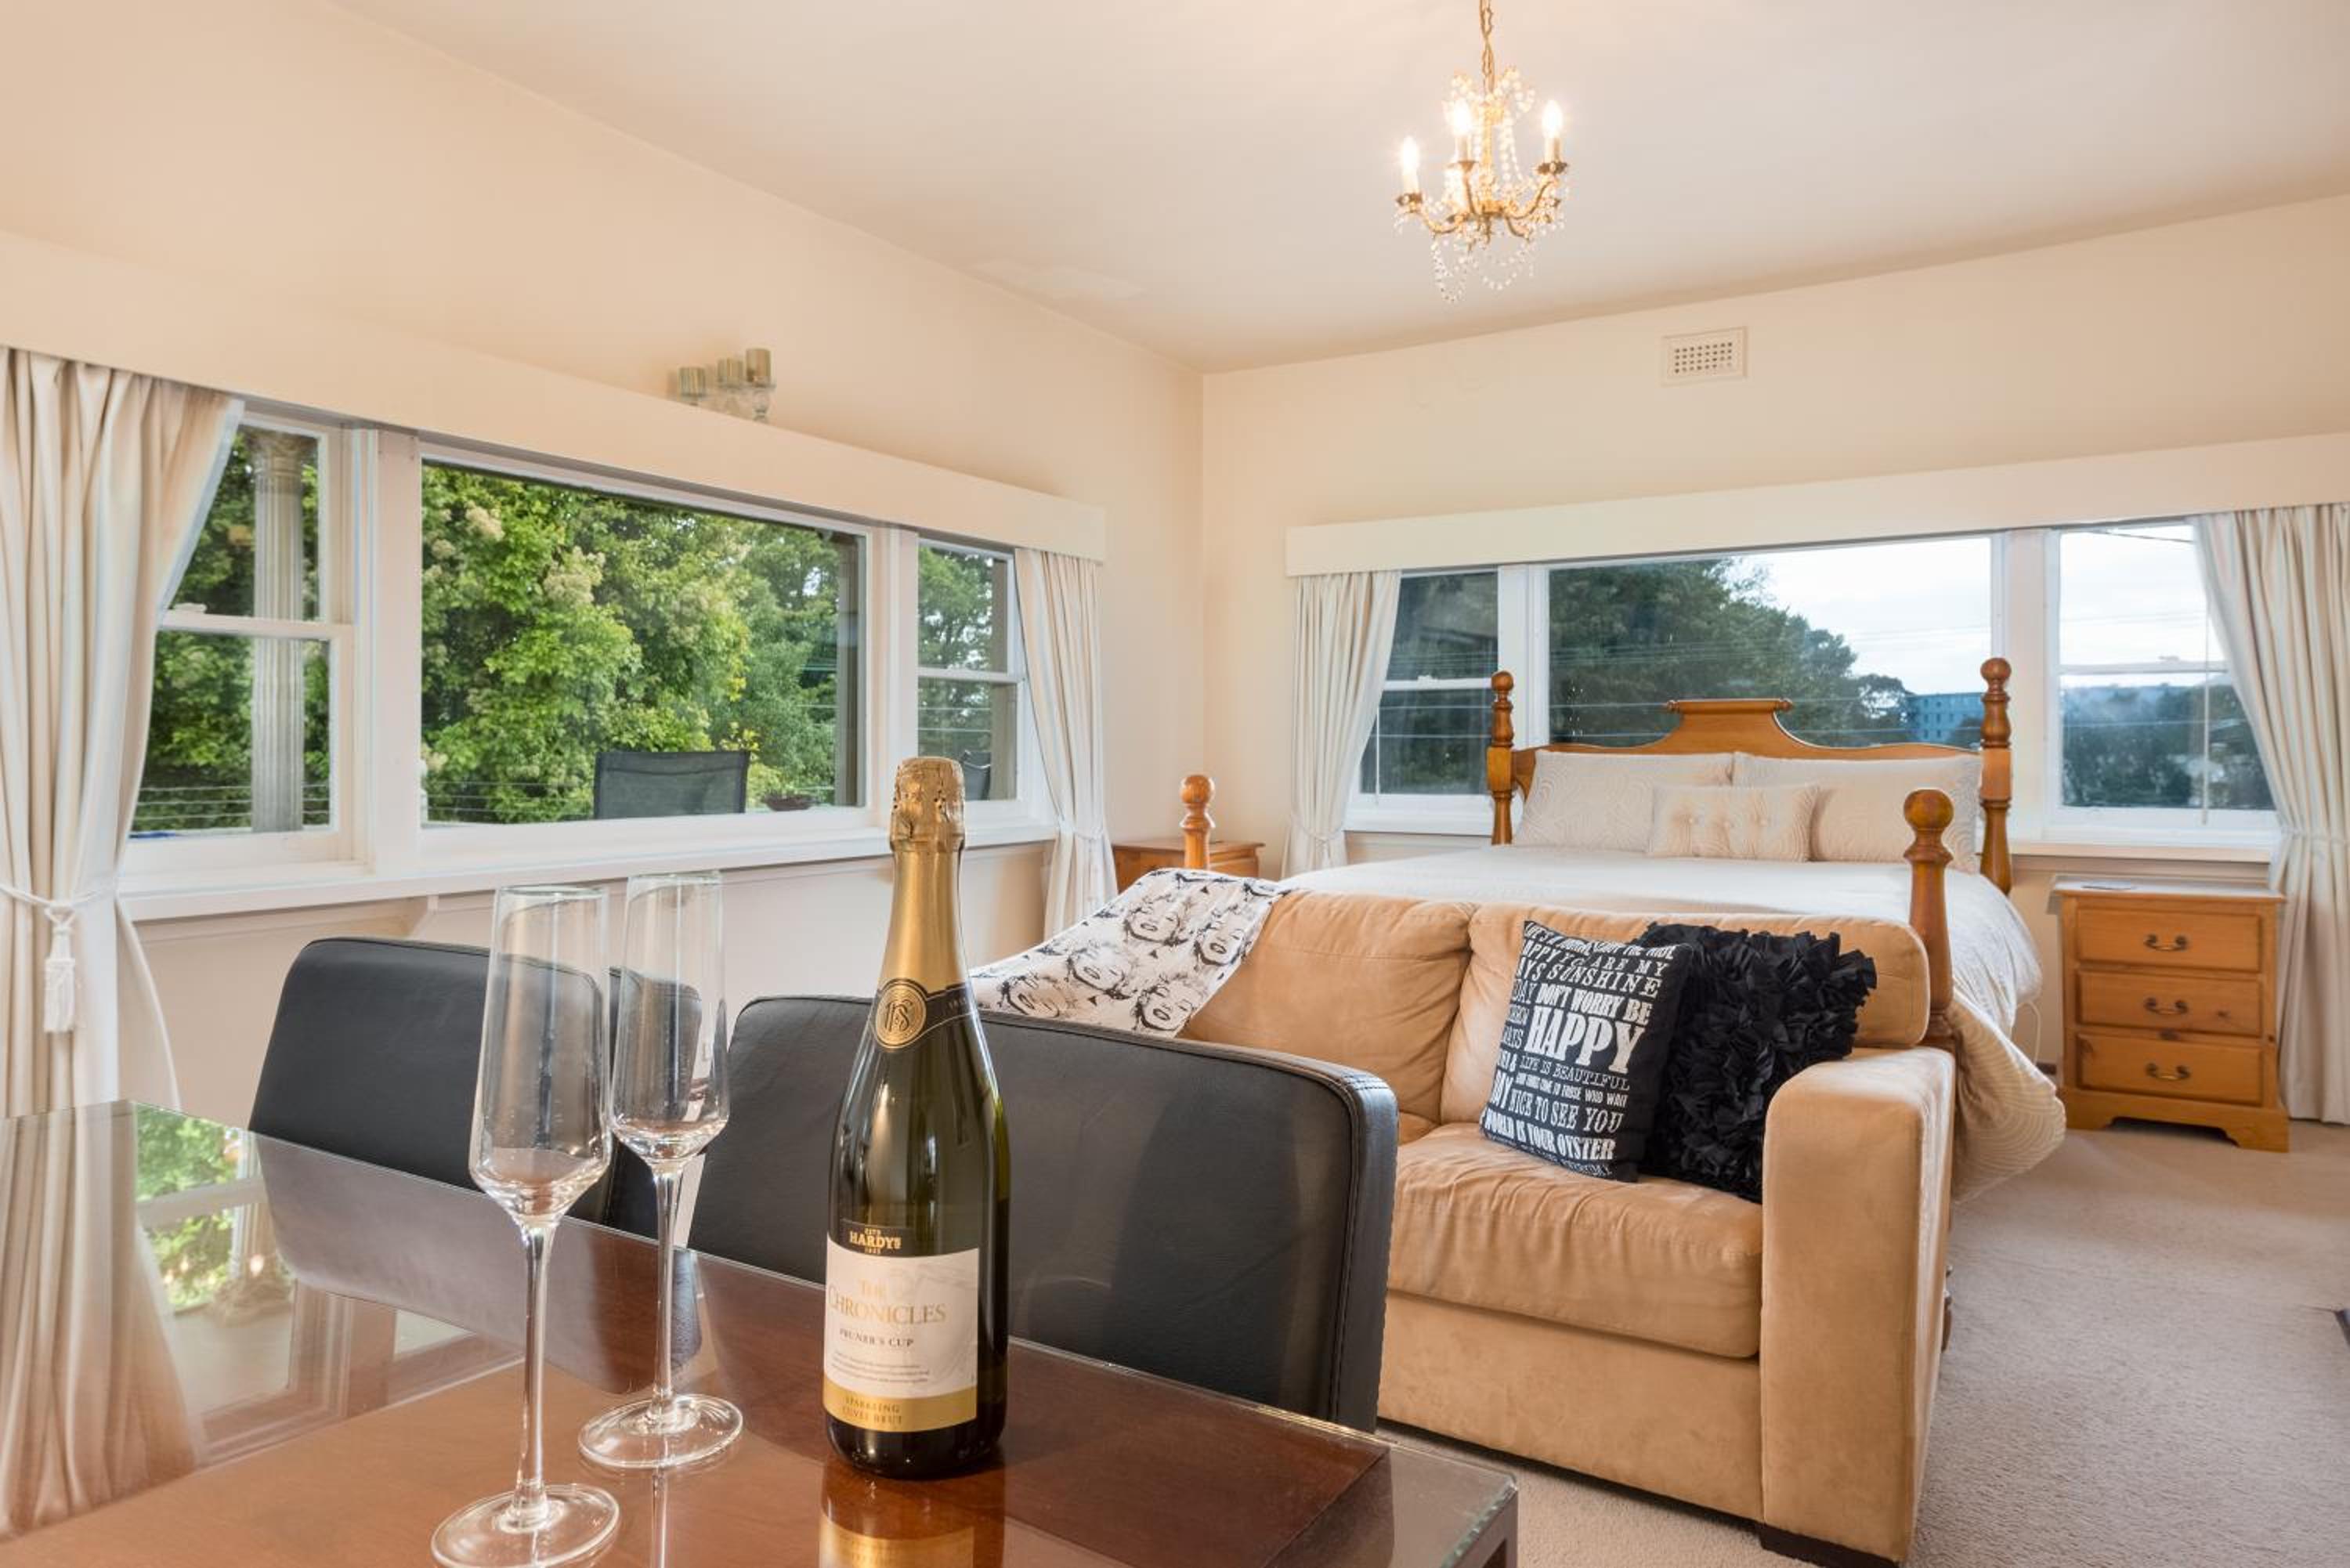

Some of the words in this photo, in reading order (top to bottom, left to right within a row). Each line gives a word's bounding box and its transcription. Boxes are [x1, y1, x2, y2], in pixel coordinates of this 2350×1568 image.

[1546, 963, 1662, 999] SUNSHINE
[1590, 955, 1629, 970] ARE
[1635, 959, 1669, 977] MY
[1535, 982, 1572, 1008] DON'T
[1571, 988, 1625, 1017] WORRY
[1623, 998, 1652, 1025] BE
[1524, 1005, 1645, 1074] HAPPY
[1520, 1055, 1540, 1071] LIFE
[1540, 1060, 1552, 1075] IS
[1553, 1063, 1629, 1091] BEAUTIFUL
[1508, 1089, 1533, 1117] NICE
[1535, 1096, 1549, 1123] TO
[1550, 1100, 1579, 1129] SEE
[1583, 1107, 1624, 1133] YOU
[1527, 1122, 1556, 1154] YOUR
[1557, 1133, 1617, 1160] OYSTER
[849, 1230, 902, 1249] HARDYS
[828, 1284, 946, 1324] CHRONICLES
[889, 1337, 914, 1348] CUP
